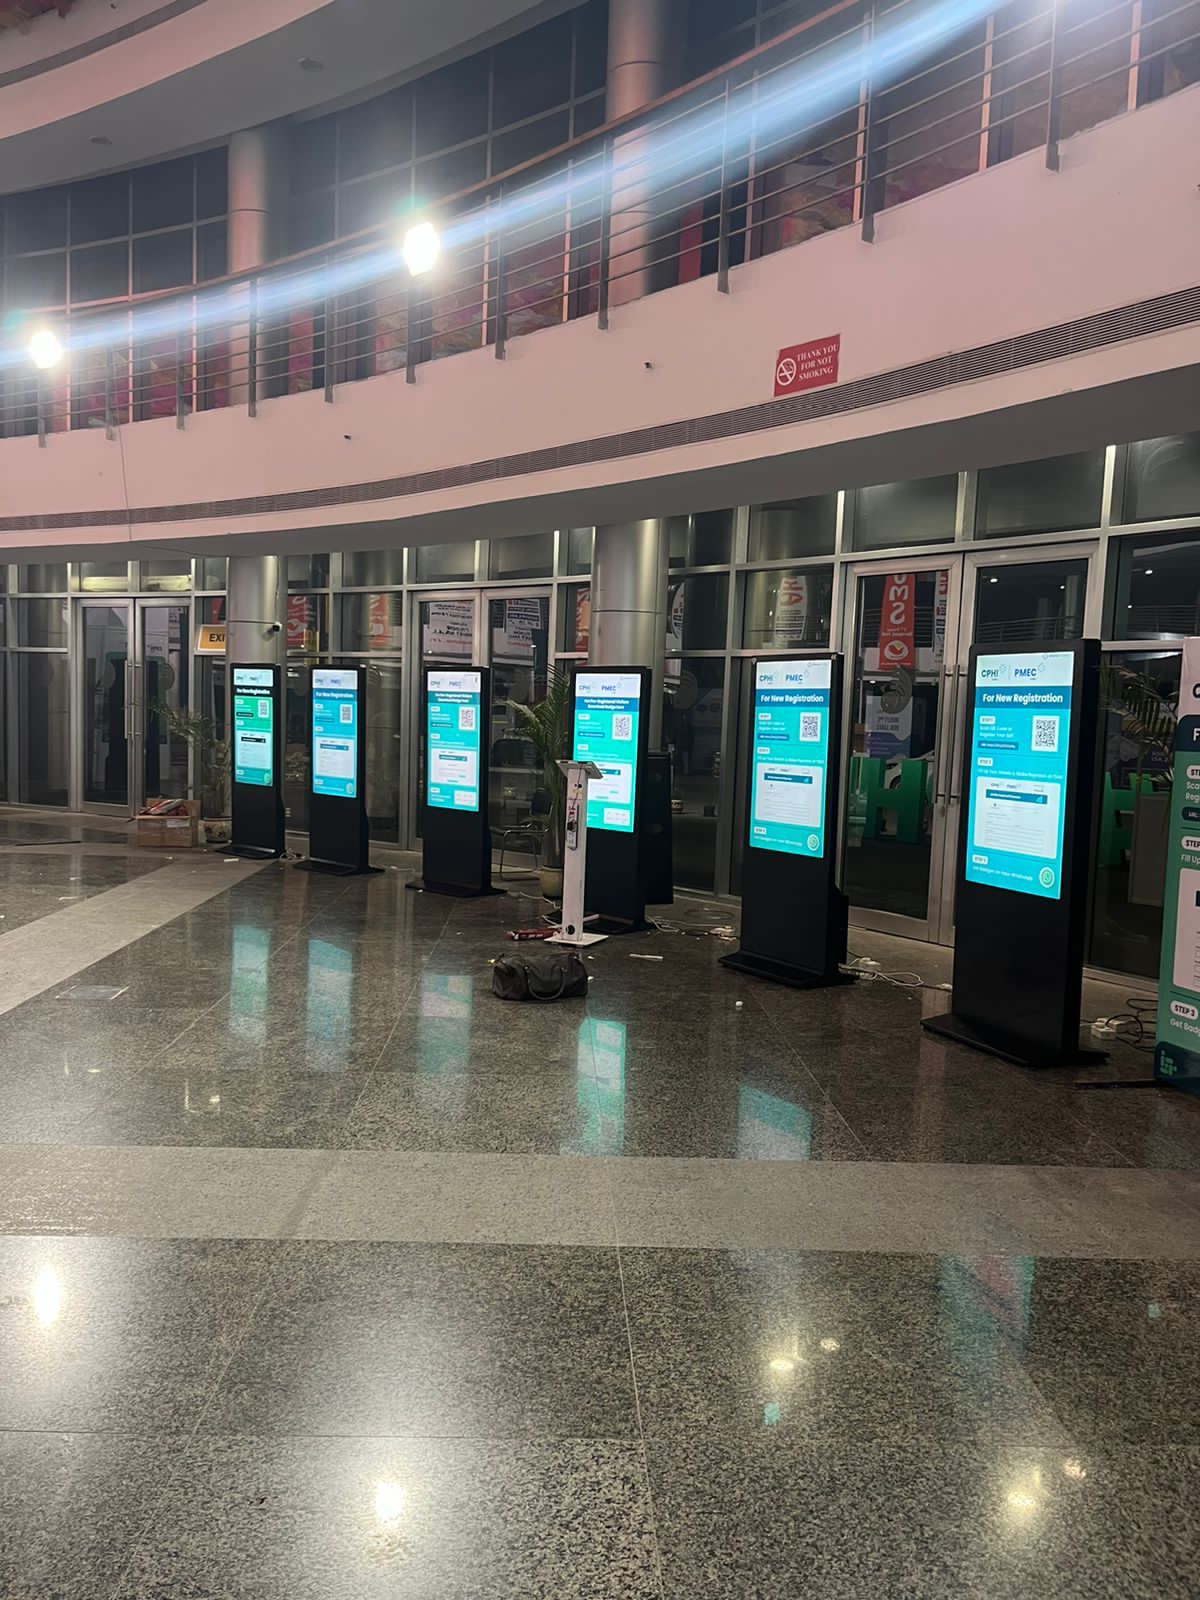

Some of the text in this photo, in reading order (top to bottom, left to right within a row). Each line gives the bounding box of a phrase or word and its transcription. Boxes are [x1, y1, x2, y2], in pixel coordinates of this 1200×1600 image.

[797, 344, 839, 362] THANK YOU
[801, 356, 832, 370] FOR NOT
[799, 367, 833, 380] SMOKING
[209, 633, 225, 642] EXI
[981, 668, 1037, 678] CPHI PMEC
[760, 694, 824, 704] For New Registration
[982, 693, 1064, 705] For New Registration
[1174, 1004, 1189, 1014] STEP
[1170, 1018, 1182, 1028] Get
